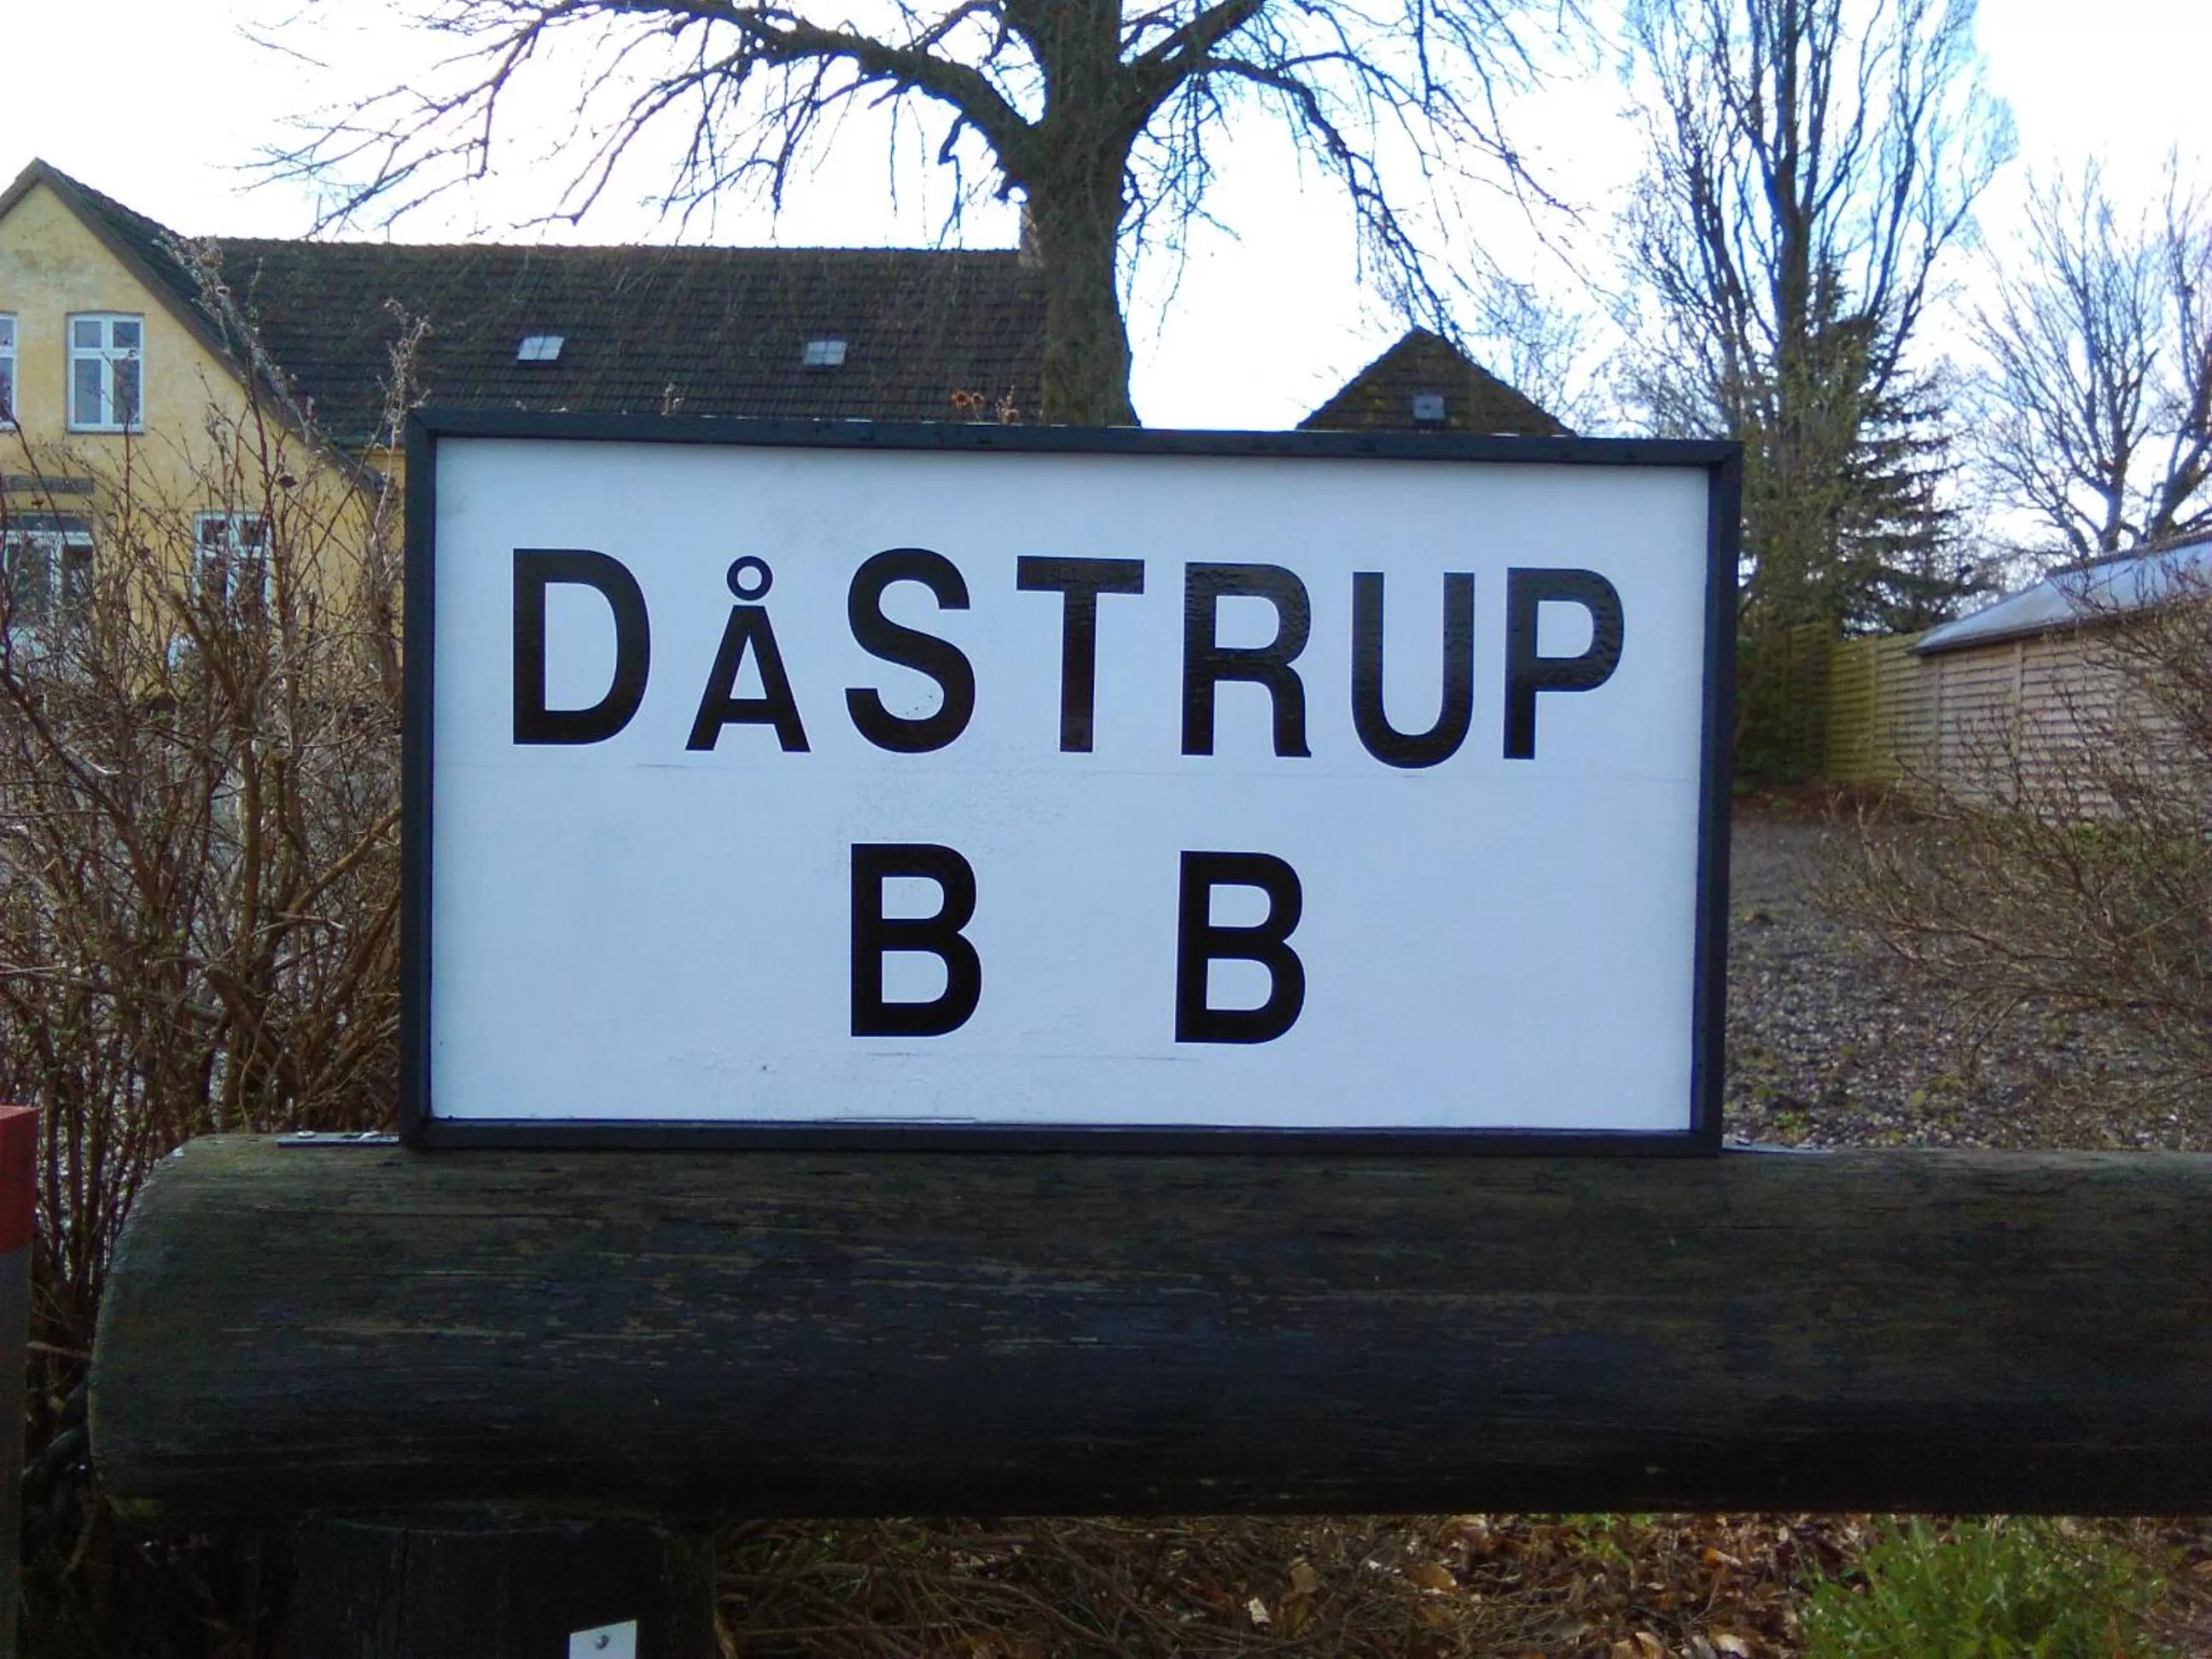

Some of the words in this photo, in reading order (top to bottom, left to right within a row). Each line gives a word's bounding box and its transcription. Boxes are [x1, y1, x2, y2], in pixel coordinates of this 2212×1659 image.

[513, 547, 1624, 770] DÅSTRUP
[851, 842, 981, 1037] B
[1175, 850, 1306, 1045] B
